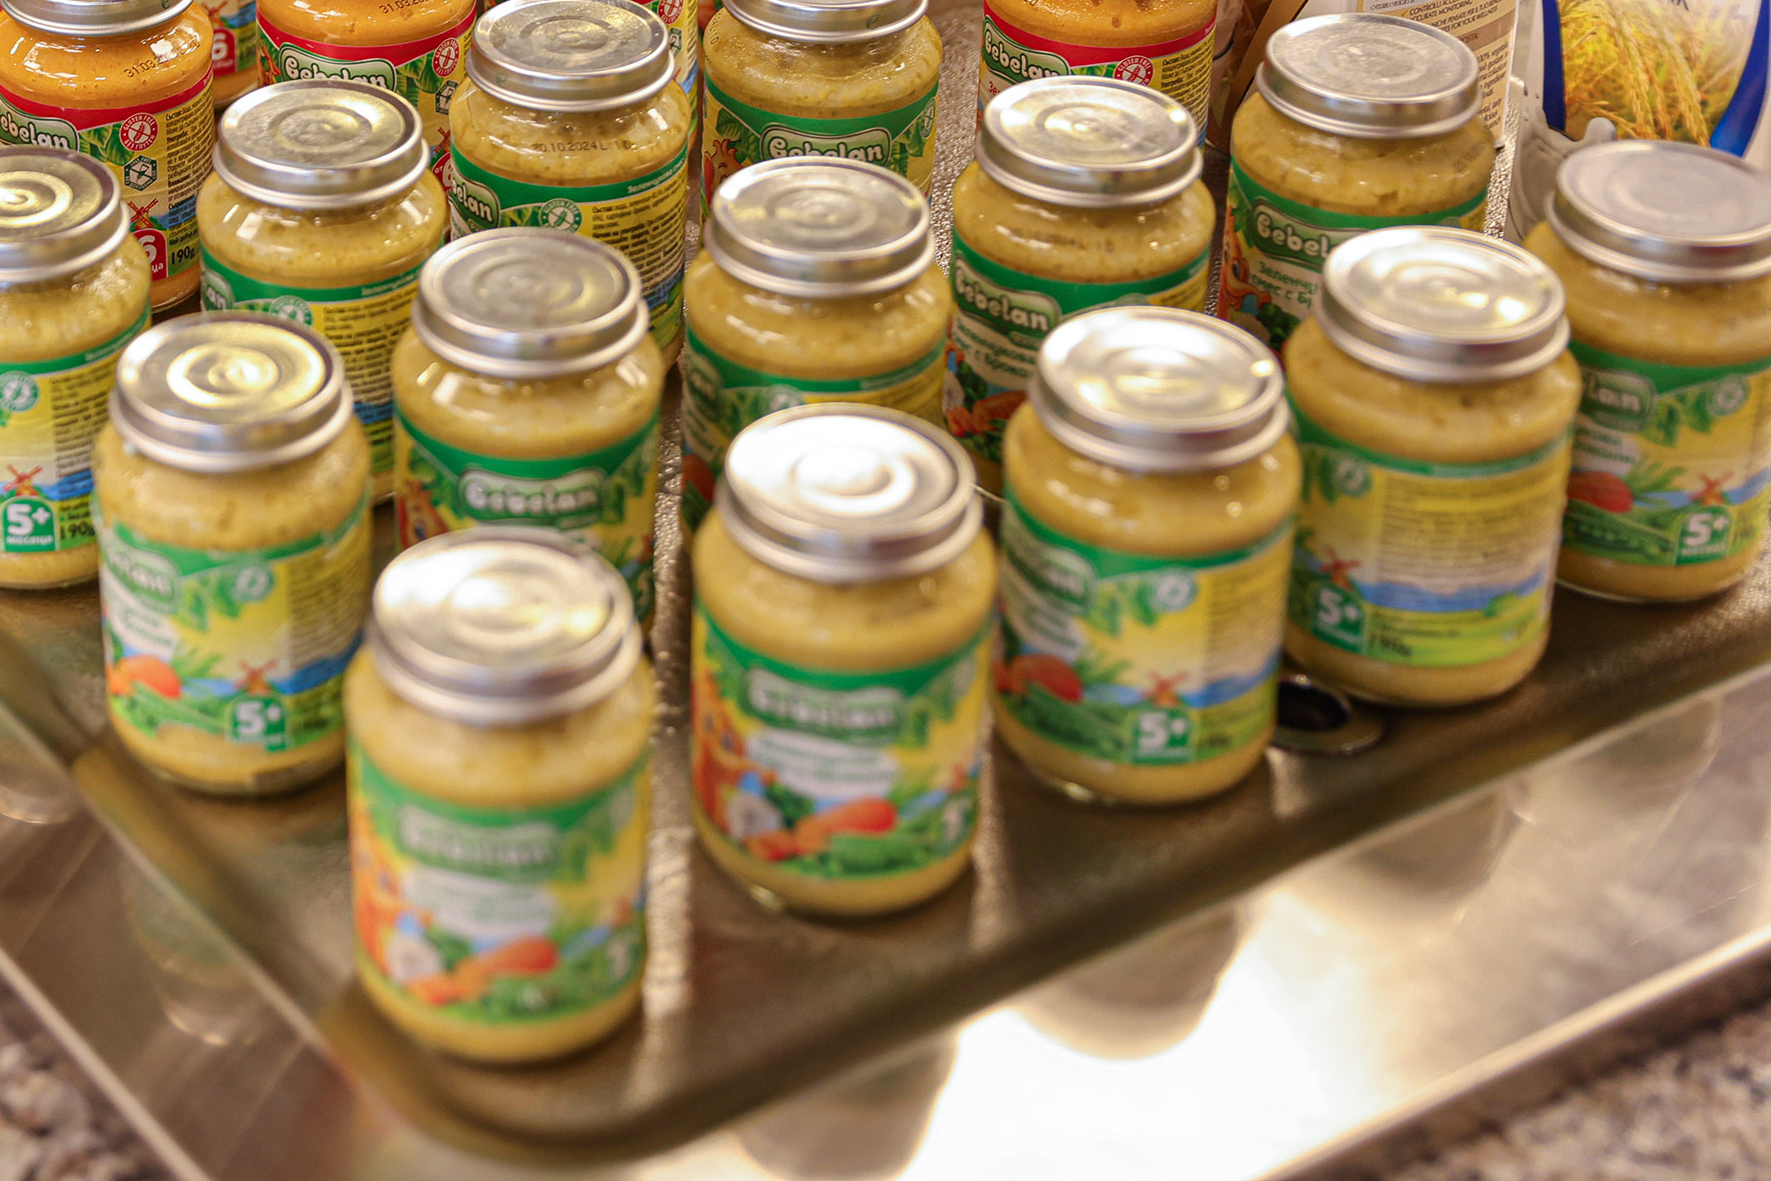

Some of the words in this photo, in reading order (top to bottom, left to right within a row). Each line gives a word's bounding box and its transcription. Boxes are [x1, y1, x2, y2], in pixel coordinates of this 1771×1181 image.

[532, 141, 598, 154] 20.10.2024
[1256, 212, 1328, 258] Bebel
[6, 503, 51, 536] 5+
